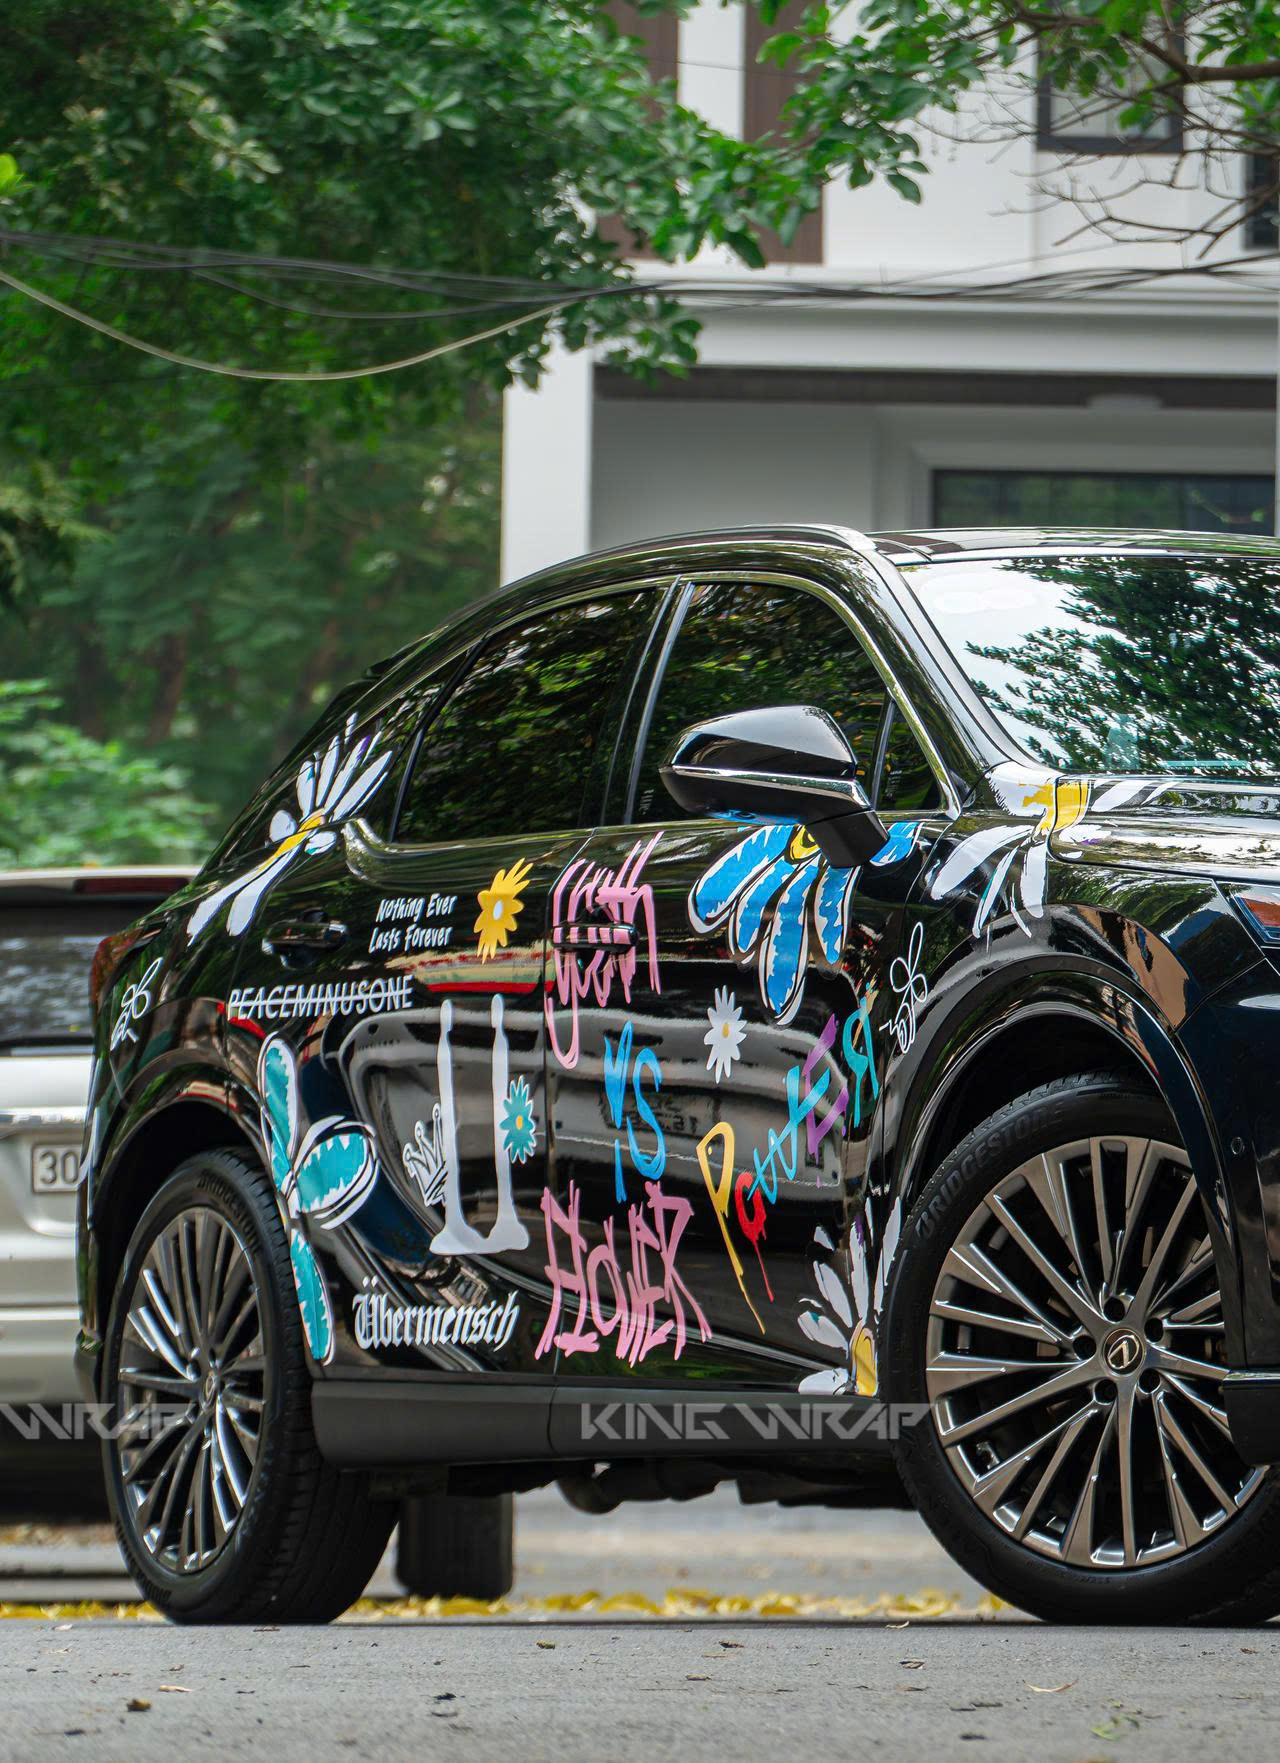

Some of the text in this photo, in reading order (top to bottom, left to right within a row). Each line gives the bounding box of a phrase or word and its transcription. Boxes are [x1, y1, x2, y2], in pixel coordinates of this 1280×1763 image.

[375, 893, 457, 923] Nothing Ever
[368, 923, 454, 954] Lasts Forever
[227, 974, 415, 1021] PEACEMINUSONE
[352, 1275, 520, 1352] Übermensch
